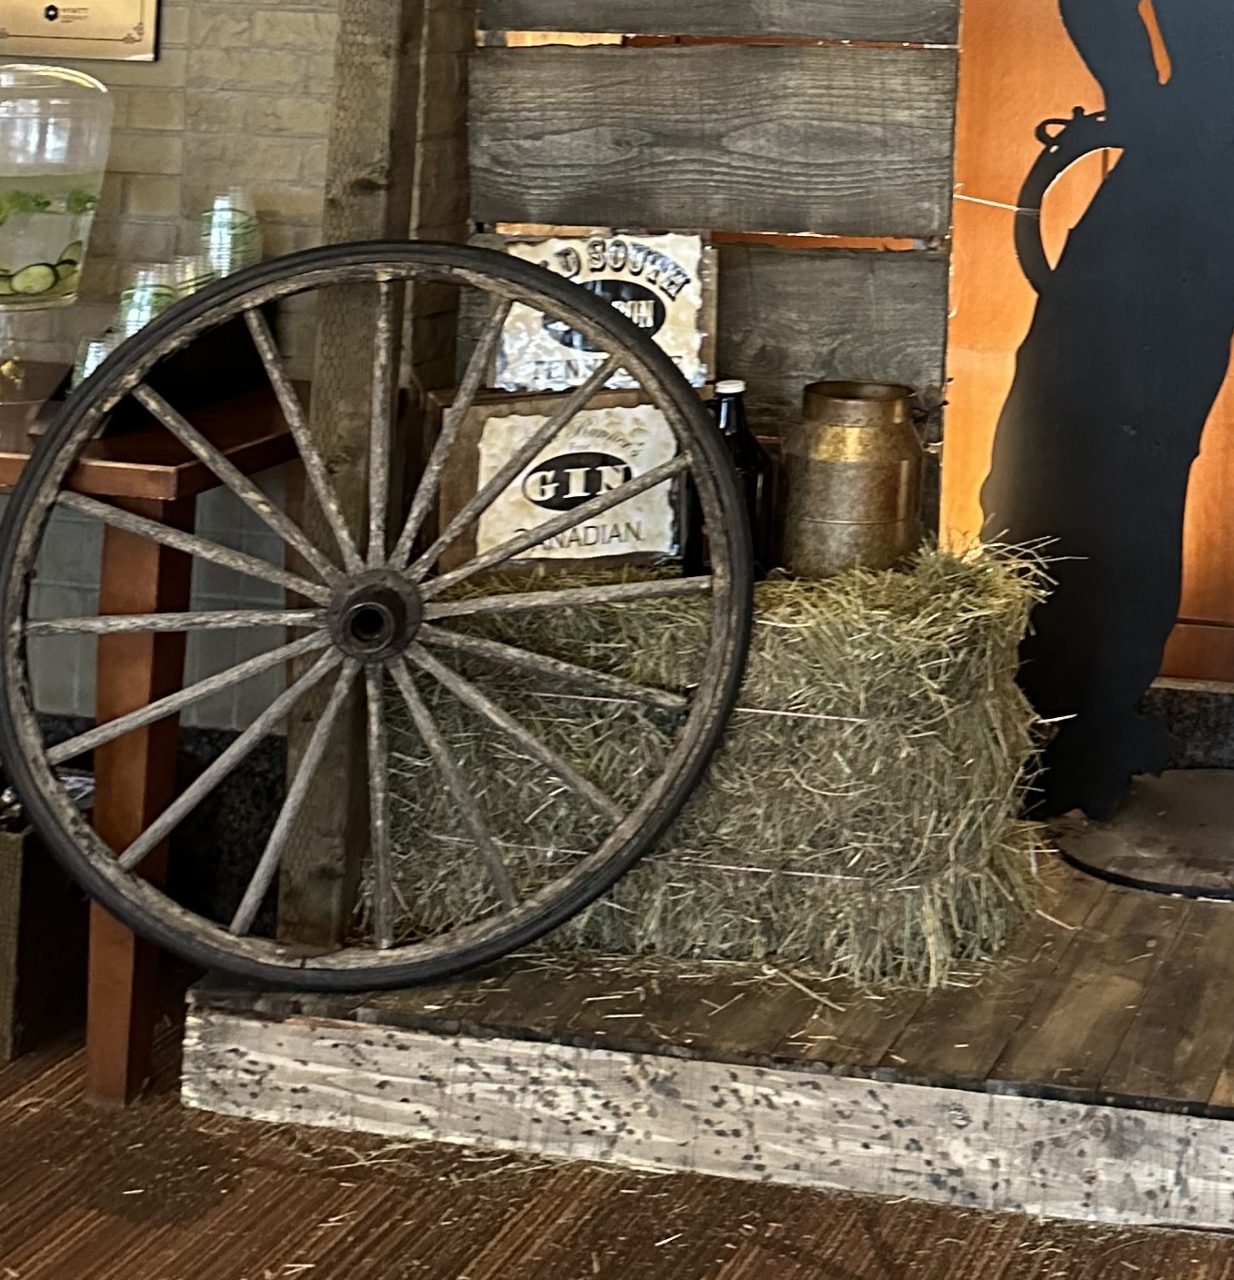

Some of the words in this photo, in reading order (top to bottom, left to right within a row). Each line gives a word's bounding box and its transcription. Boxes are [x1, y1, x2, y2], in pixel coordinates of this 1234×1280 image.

[587, 239, 691, 301] SOUTH
[525, 464, 630, 502] GIN
[514, 520, 645, 551] NADIAN
